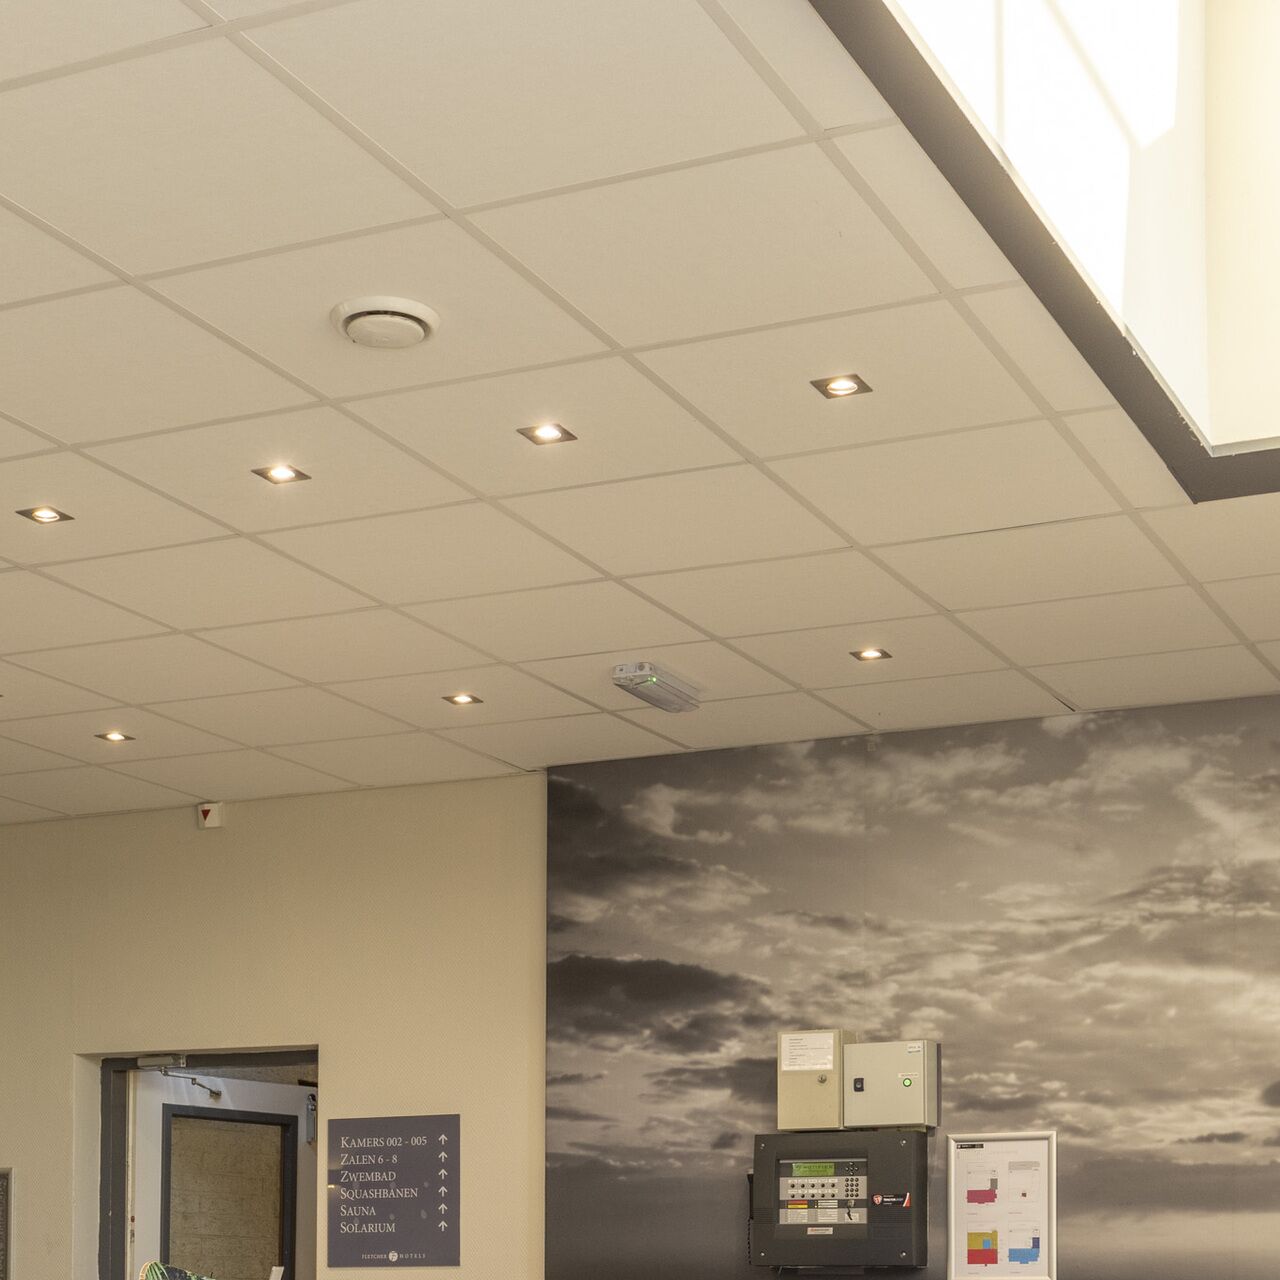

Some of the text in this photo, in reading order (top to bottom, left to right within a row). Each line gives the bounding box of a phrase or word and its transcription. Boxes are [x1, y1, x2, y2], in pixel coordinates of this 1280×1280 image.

[341, 1136, 385, 1149] KAMERS
[386, 1137, 402, 1147] 002
[411, 1136, 427, 1146] 005
[340, 1153, 376, 1166] ZALEN
[378, 1155, 384, 1164] 6
[391, 1154, 398, 1164] 8
[340, 1170, 397, 1183] ZWEMBAD
[340, 1187, 418, 1201] SQUASHBANEN
[340, 1204, 376, 1217] SAUNA
[340, 1221, 396, 1234] SOLARIUM
